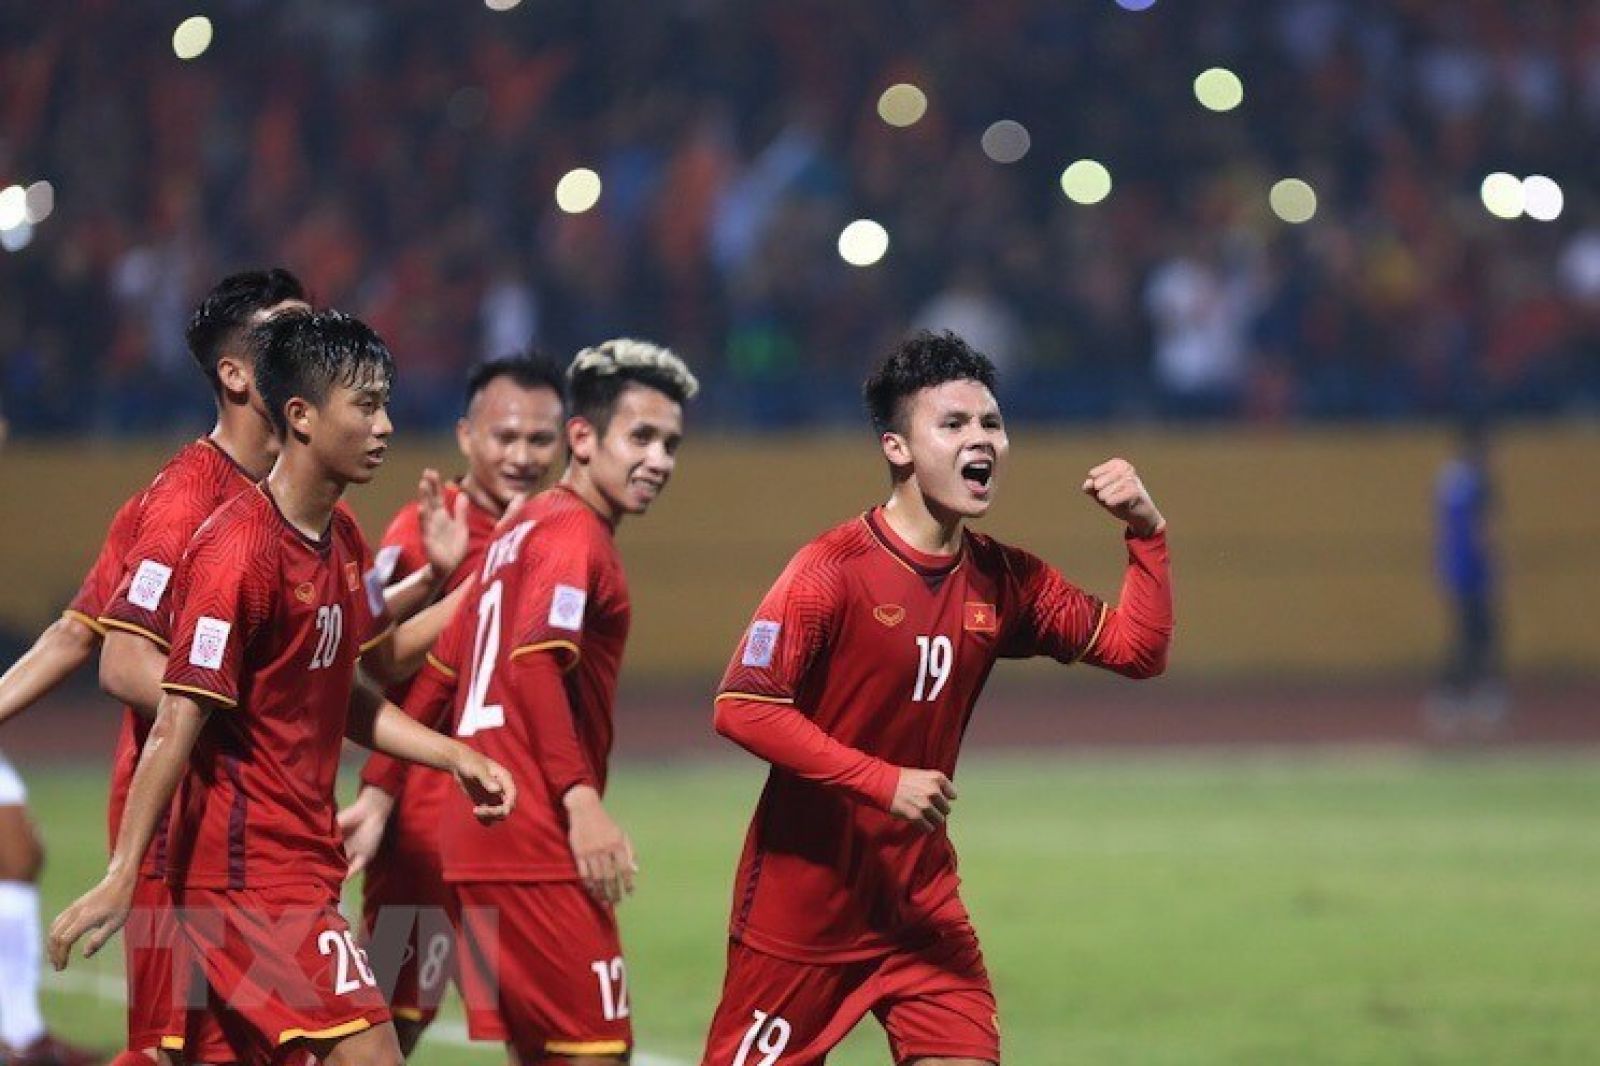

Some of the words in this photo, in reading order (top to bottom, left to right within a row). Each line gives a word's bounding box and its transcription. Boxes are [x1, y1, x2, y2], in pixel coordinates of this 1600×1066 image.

[307, 603, 343, 671] 20
[912, 635, 953, 702] 19
[590, 956, 629, 1021] 12
